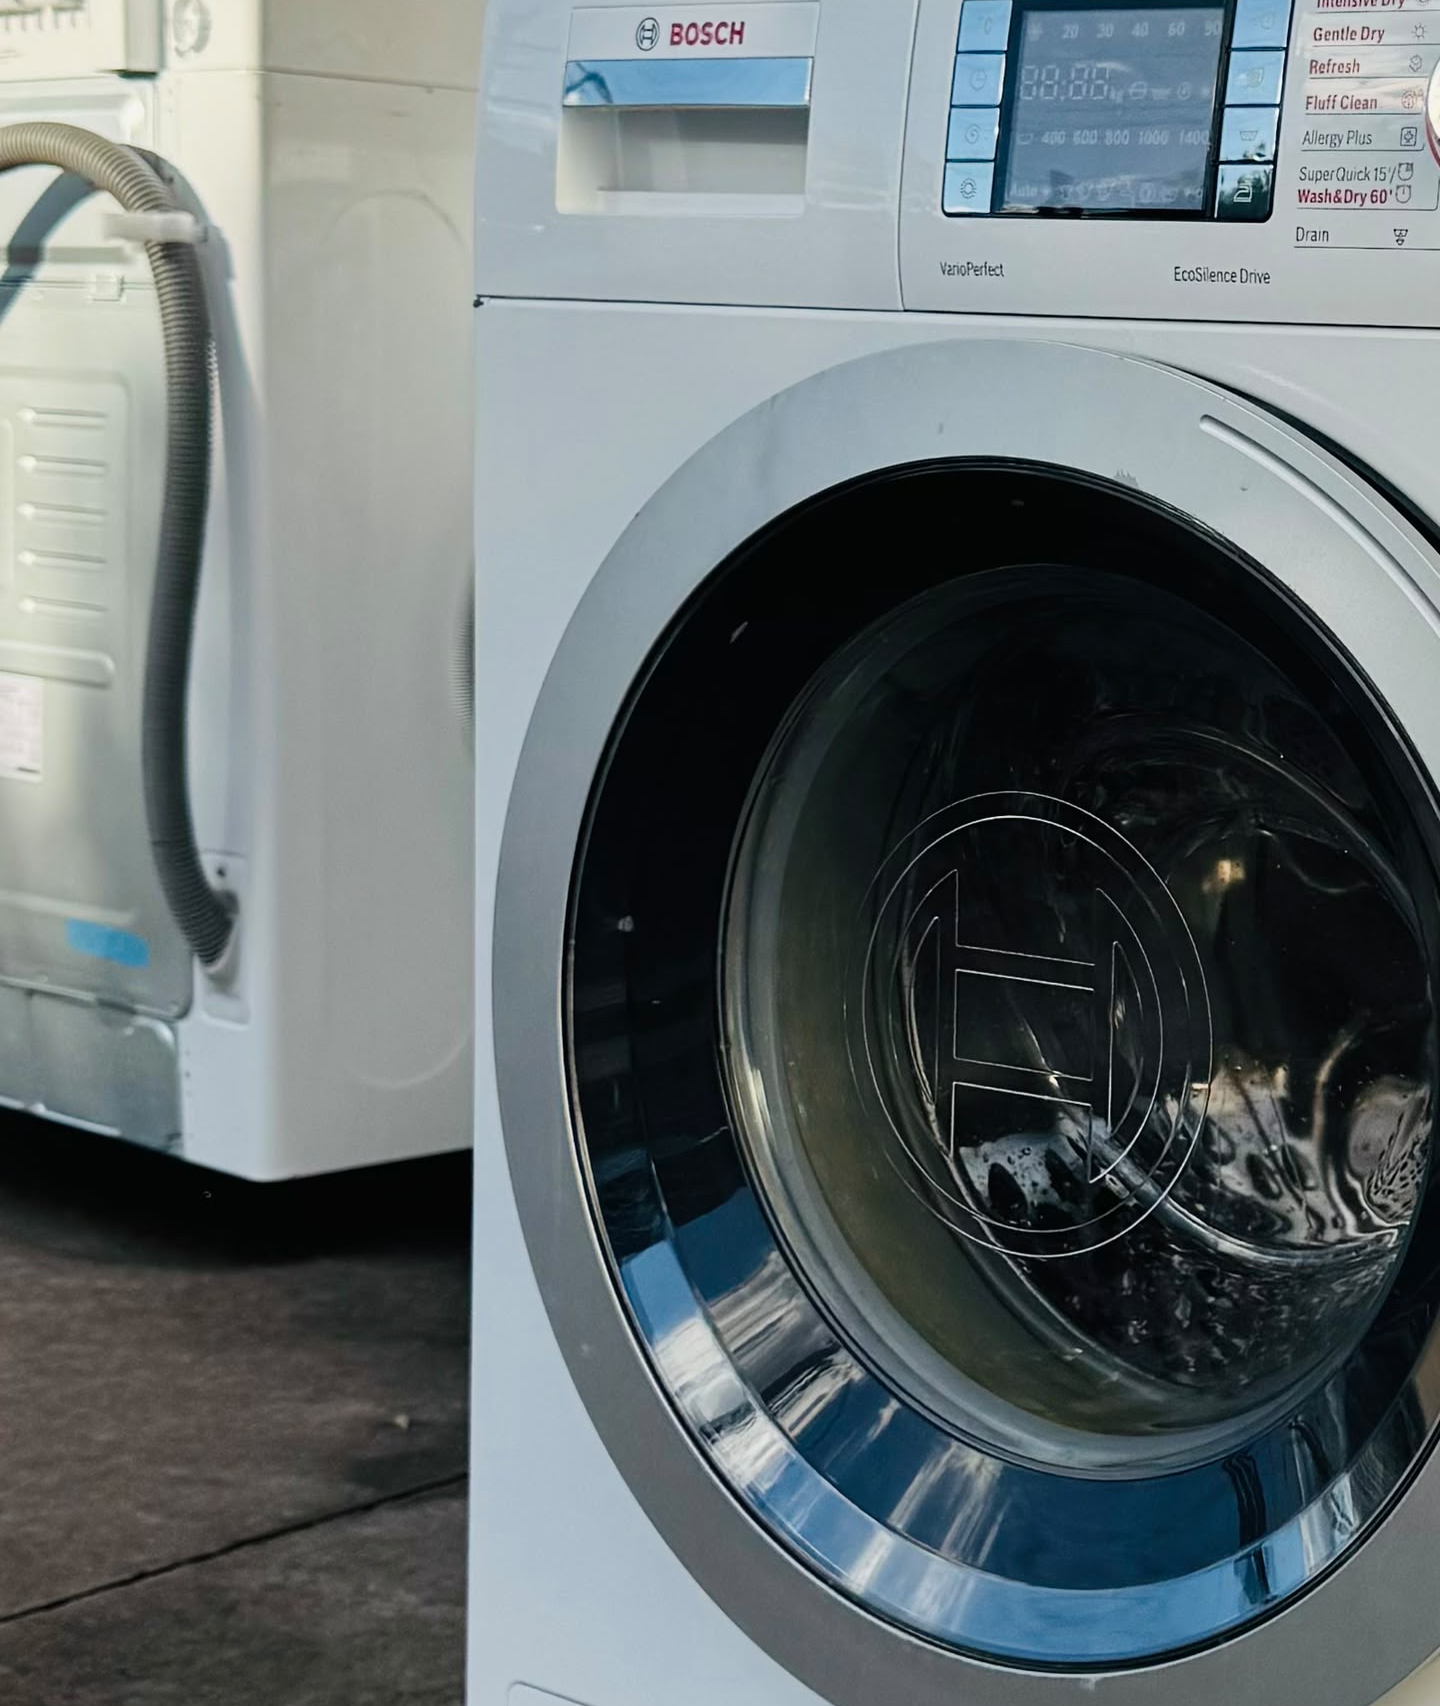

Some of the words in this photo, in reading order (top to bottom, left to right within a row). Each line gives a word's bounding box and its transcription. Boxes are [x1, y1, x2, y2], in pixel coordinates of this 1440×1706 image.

[669, 21, 745, 46] BOSCH
[1061, 23, 1080, 39] 20
[1131, 21, 1150, 38] 40
[1167, 20, 1186, 37] 60
[1313, 25, 1358, 42] Gentle
[1360, 26, 1386, 43] Dry
[1308, 58, 1361, 75] Refresh
[1305, 94, 1338, 110] Fluff
[1340, 94, 1378, 110] Clean
[1302, 130, 1345, 149] Allergy
[1346, 129, 1373, 145] Plus
[1299, 166, 1371, 184] SuperQuick
[1297, 188, 1368, 207] Wash&Dry
[1296, 226, 1330, 242] Drain
[940, 261, 1005, 278] VarioPerfect
[1173, 266, 1237, 284] EcoSilence
[1239, 267, 1271, 285] Drive
